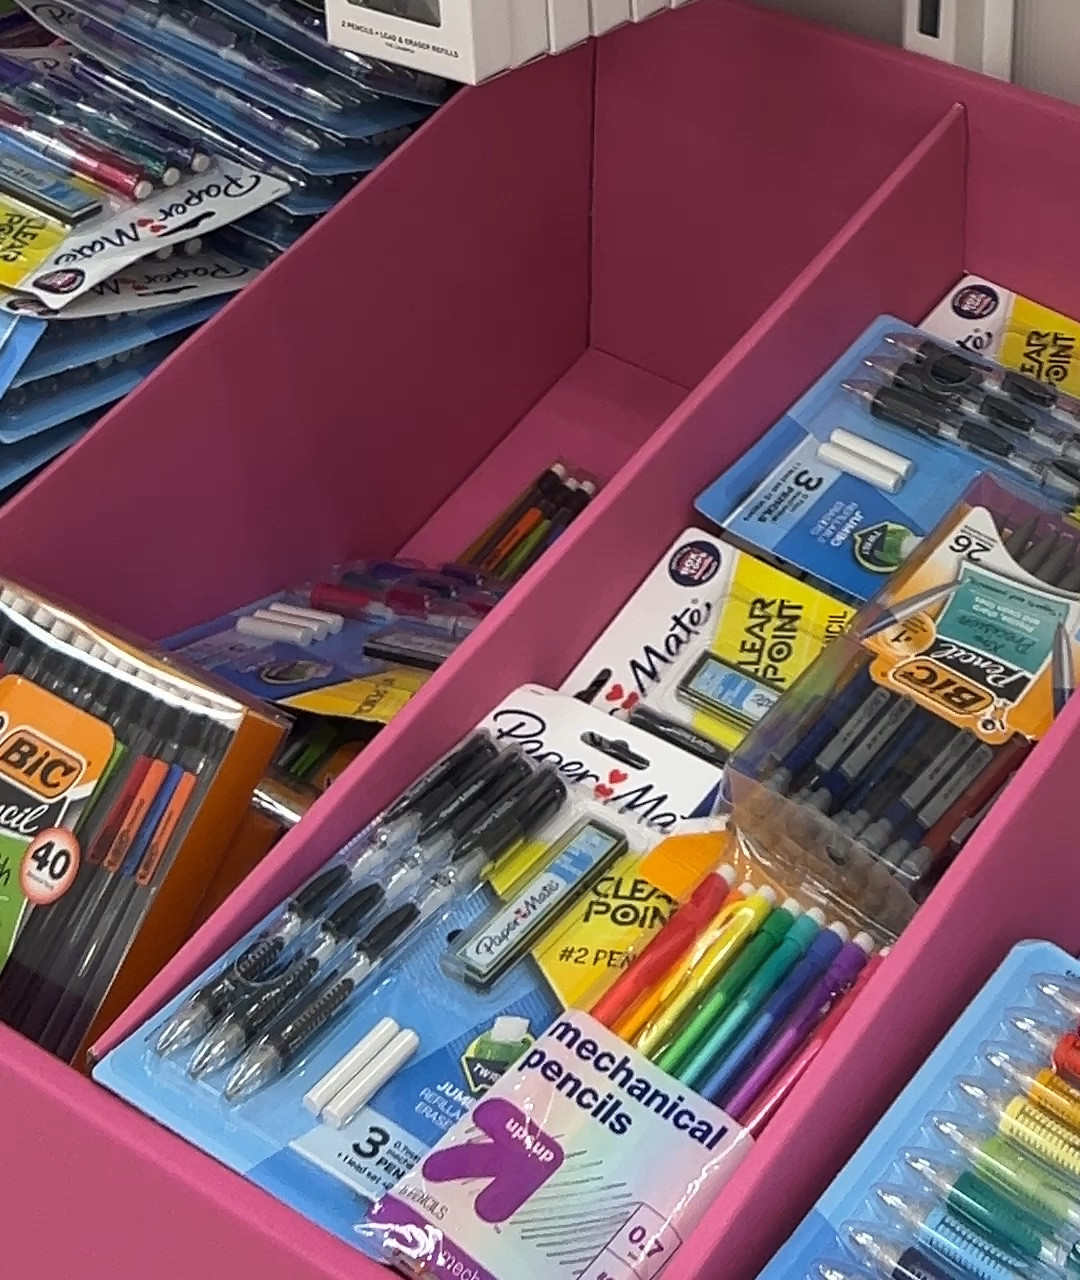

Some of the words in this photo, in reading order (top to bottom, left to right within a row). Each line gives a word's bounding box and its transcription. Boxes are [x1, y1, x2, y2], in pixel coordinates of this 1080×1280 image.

[347, 22, 374, 35] PENCILS
[380, 32, 396, 42] LEAD
[405, 38, 430, 49] ERASER
[432, 45, 458, 58] REFILLS
[949, 534, 992, 563] 26
[628, 600, 712, 692] Mate
[762, 599, 805, 683] POINT
[900, 665, 986, 708] BIC
[931, 642, 1022, 687] Pencil
[493, 708, 604, 796] Paper
[29, 841, 71, 880] 40
[475, 908, 522, 957] Paper
[558, 945, 588, 965] #2
[517, 1047, 635, 1139] pencils
[547, 1017, 731, 1151] mechanical
[352, 1126, 390, 1158] 3
